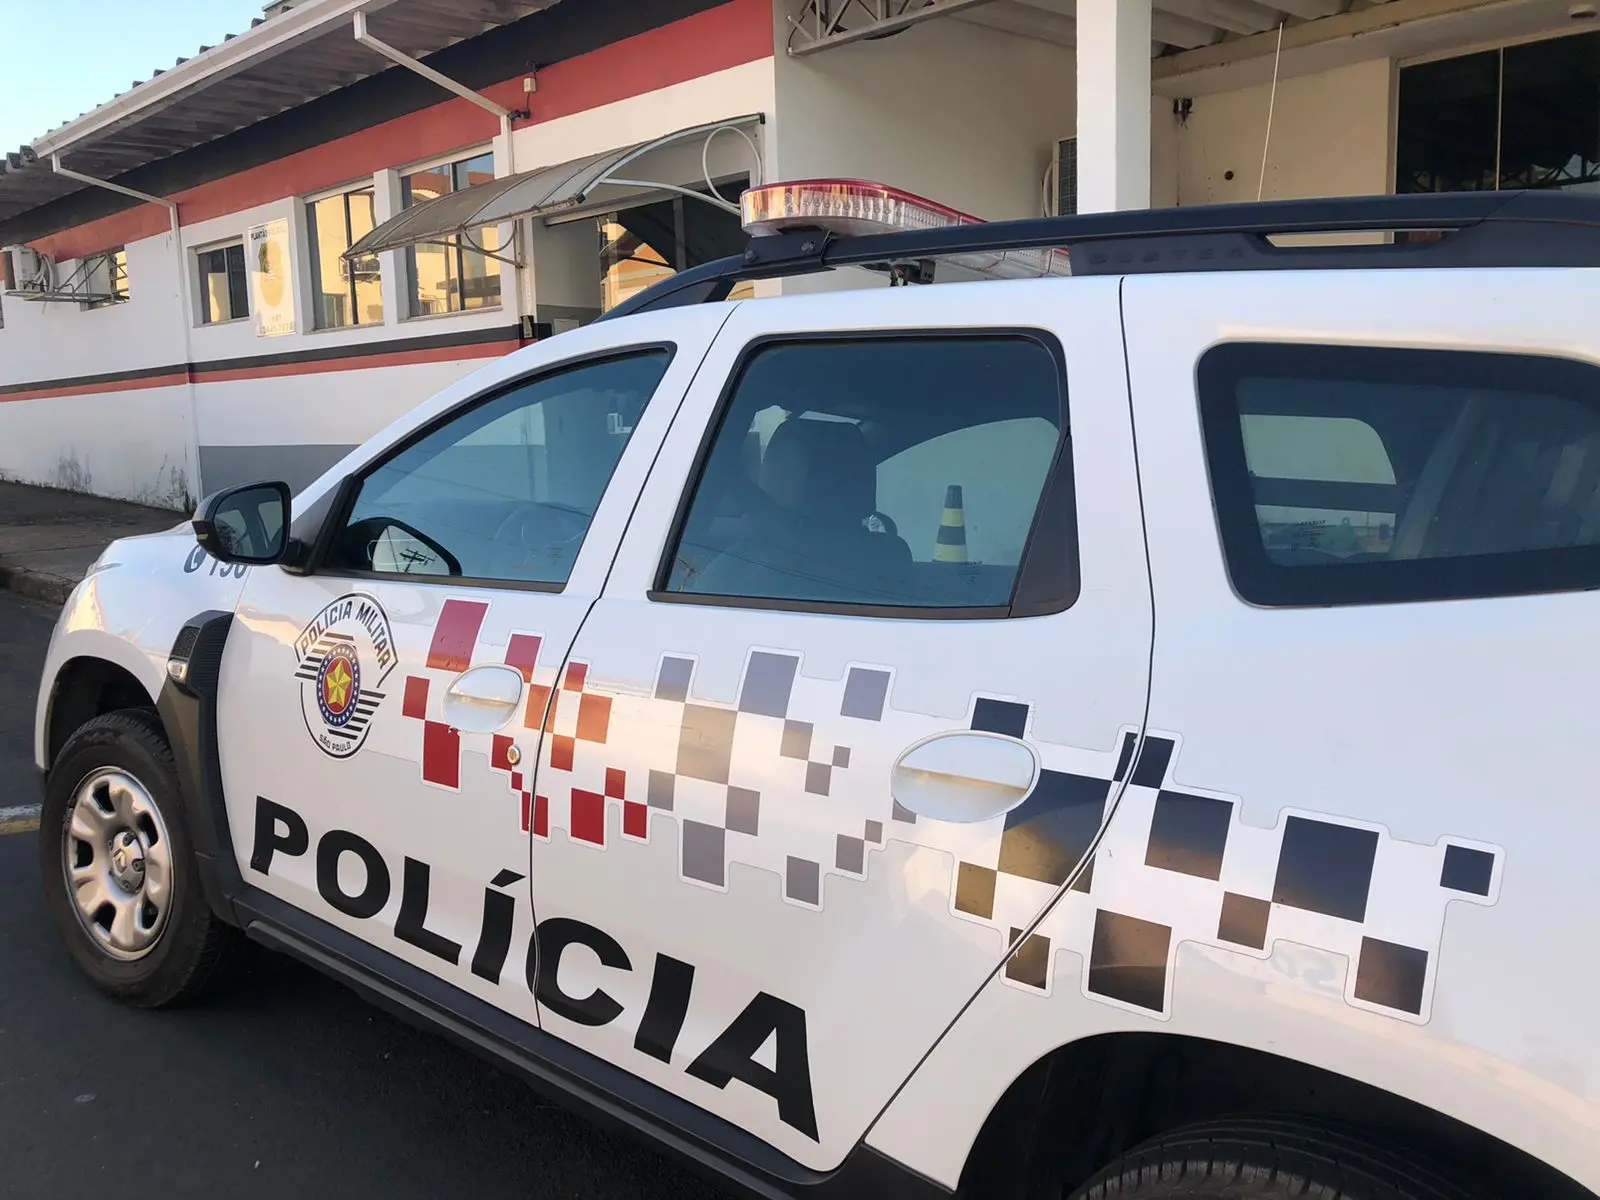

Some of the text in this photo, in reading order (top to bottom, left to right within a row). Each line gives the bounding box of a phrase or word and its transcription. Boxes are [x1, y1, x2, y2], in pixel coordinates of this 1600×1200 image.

[300, 600, 391, 670] POLÍCIA MILITAR
[319, 733, 351, 752] SÃO PAULO
[249, 796, 820, 1144] POLÍCIA
